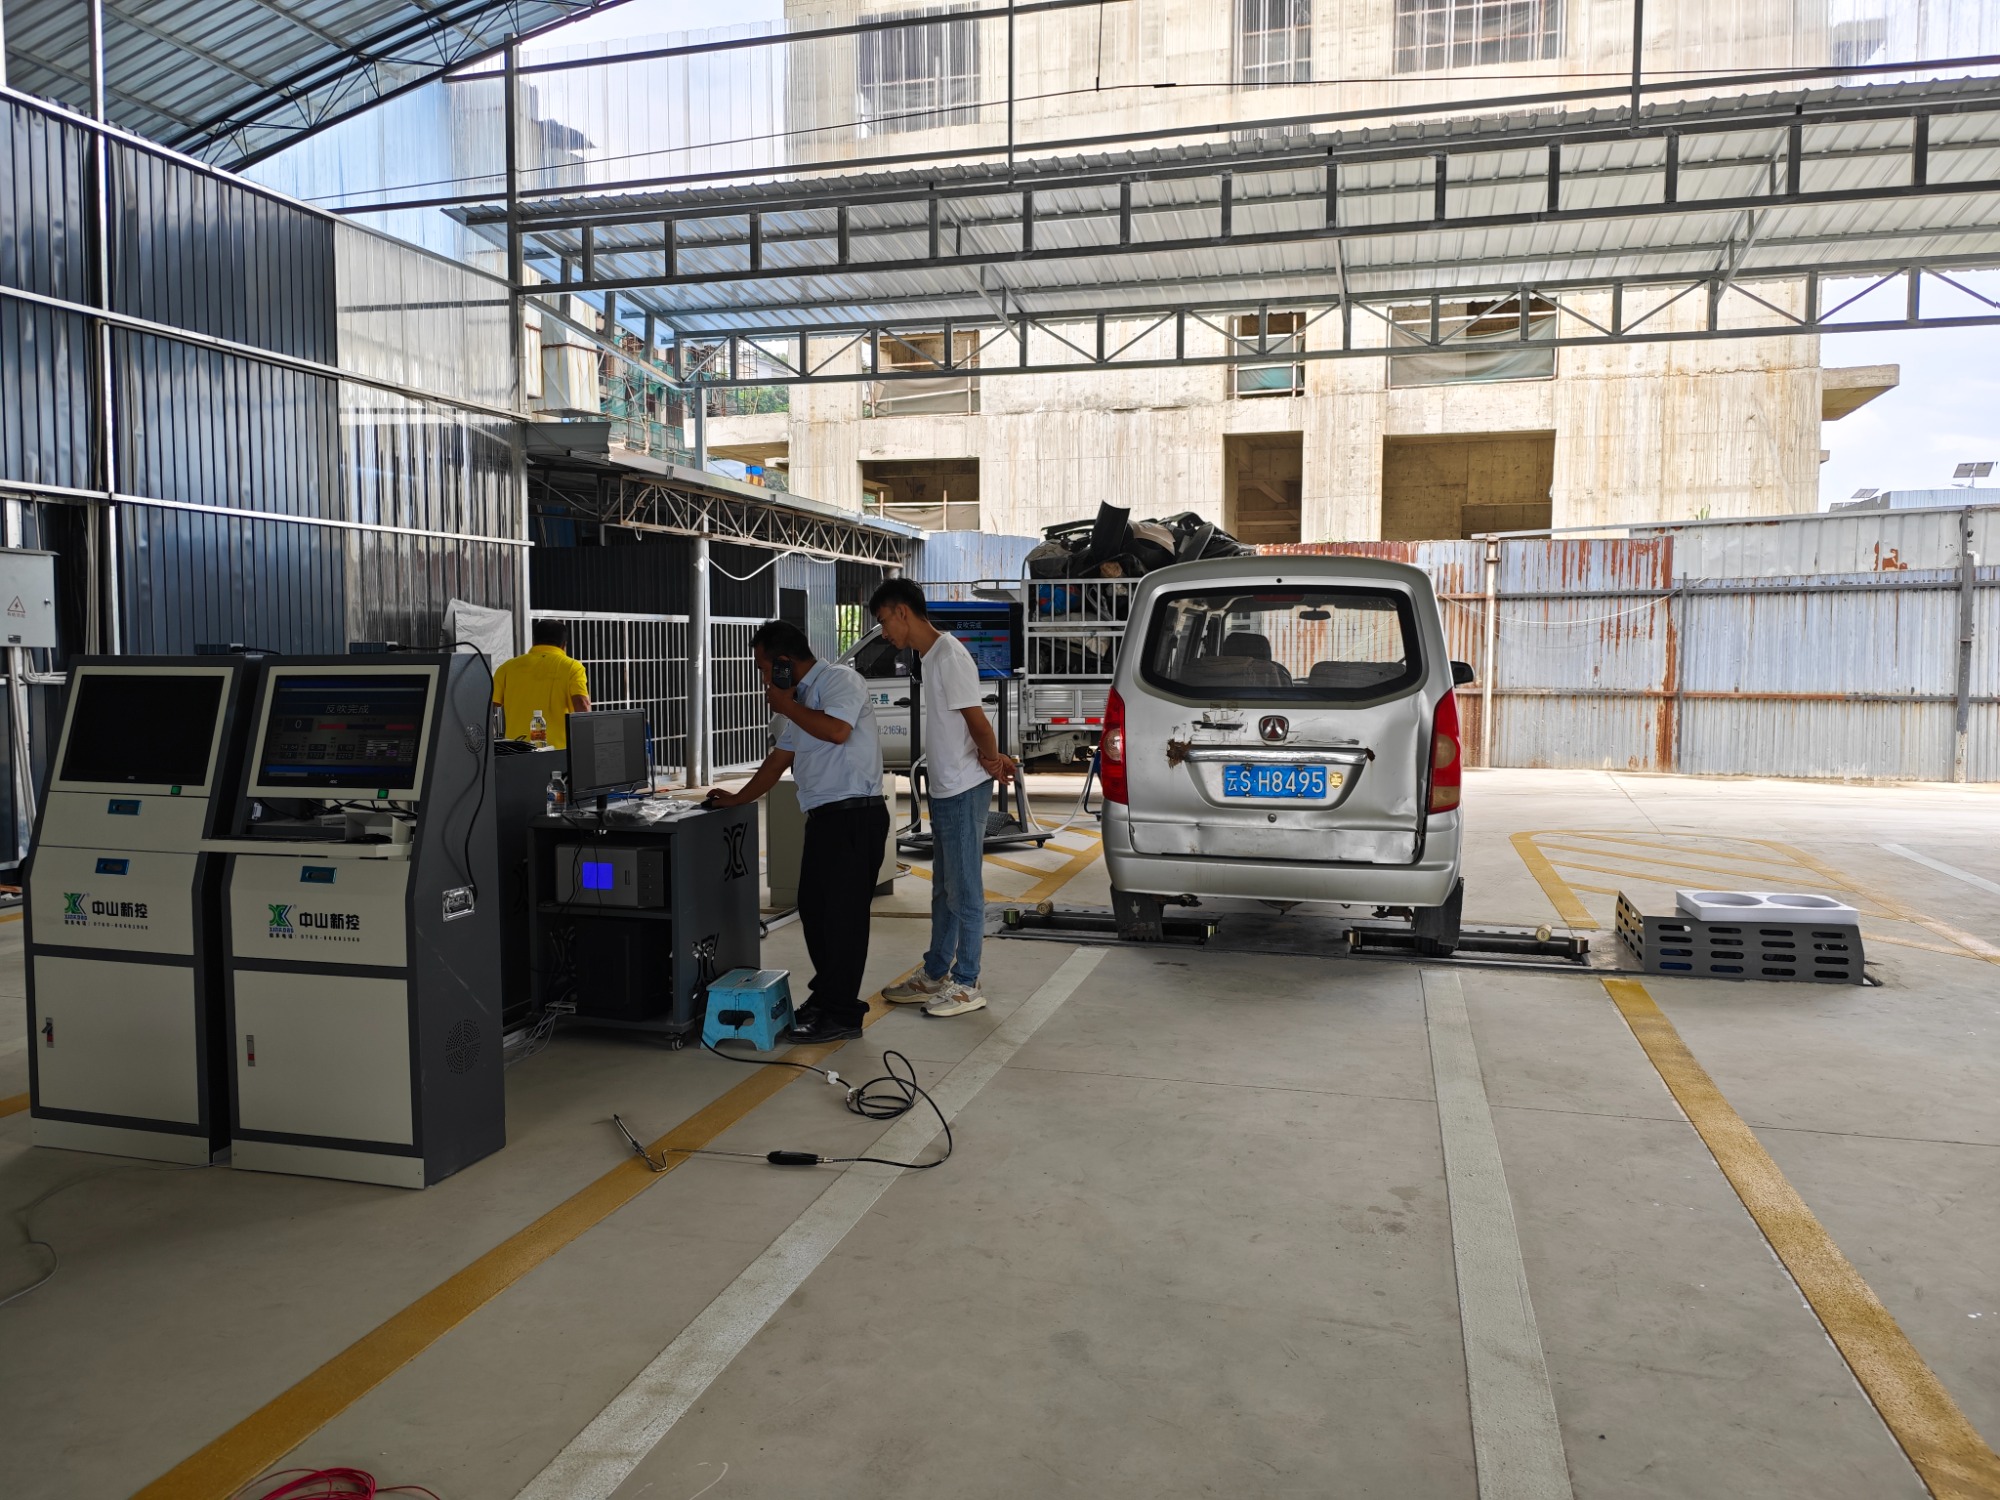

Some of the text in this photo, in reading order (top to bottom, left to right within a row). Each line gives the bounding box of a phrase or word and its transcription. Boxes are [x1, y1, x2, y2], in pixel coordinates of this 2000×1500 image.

[325, 704, 370, 714] 反吹完成
[877, 725, 907, 736] :2165kg
[92, 900, 148, 918] 中山新控
[299, 912, 360, 930] 中山新控
